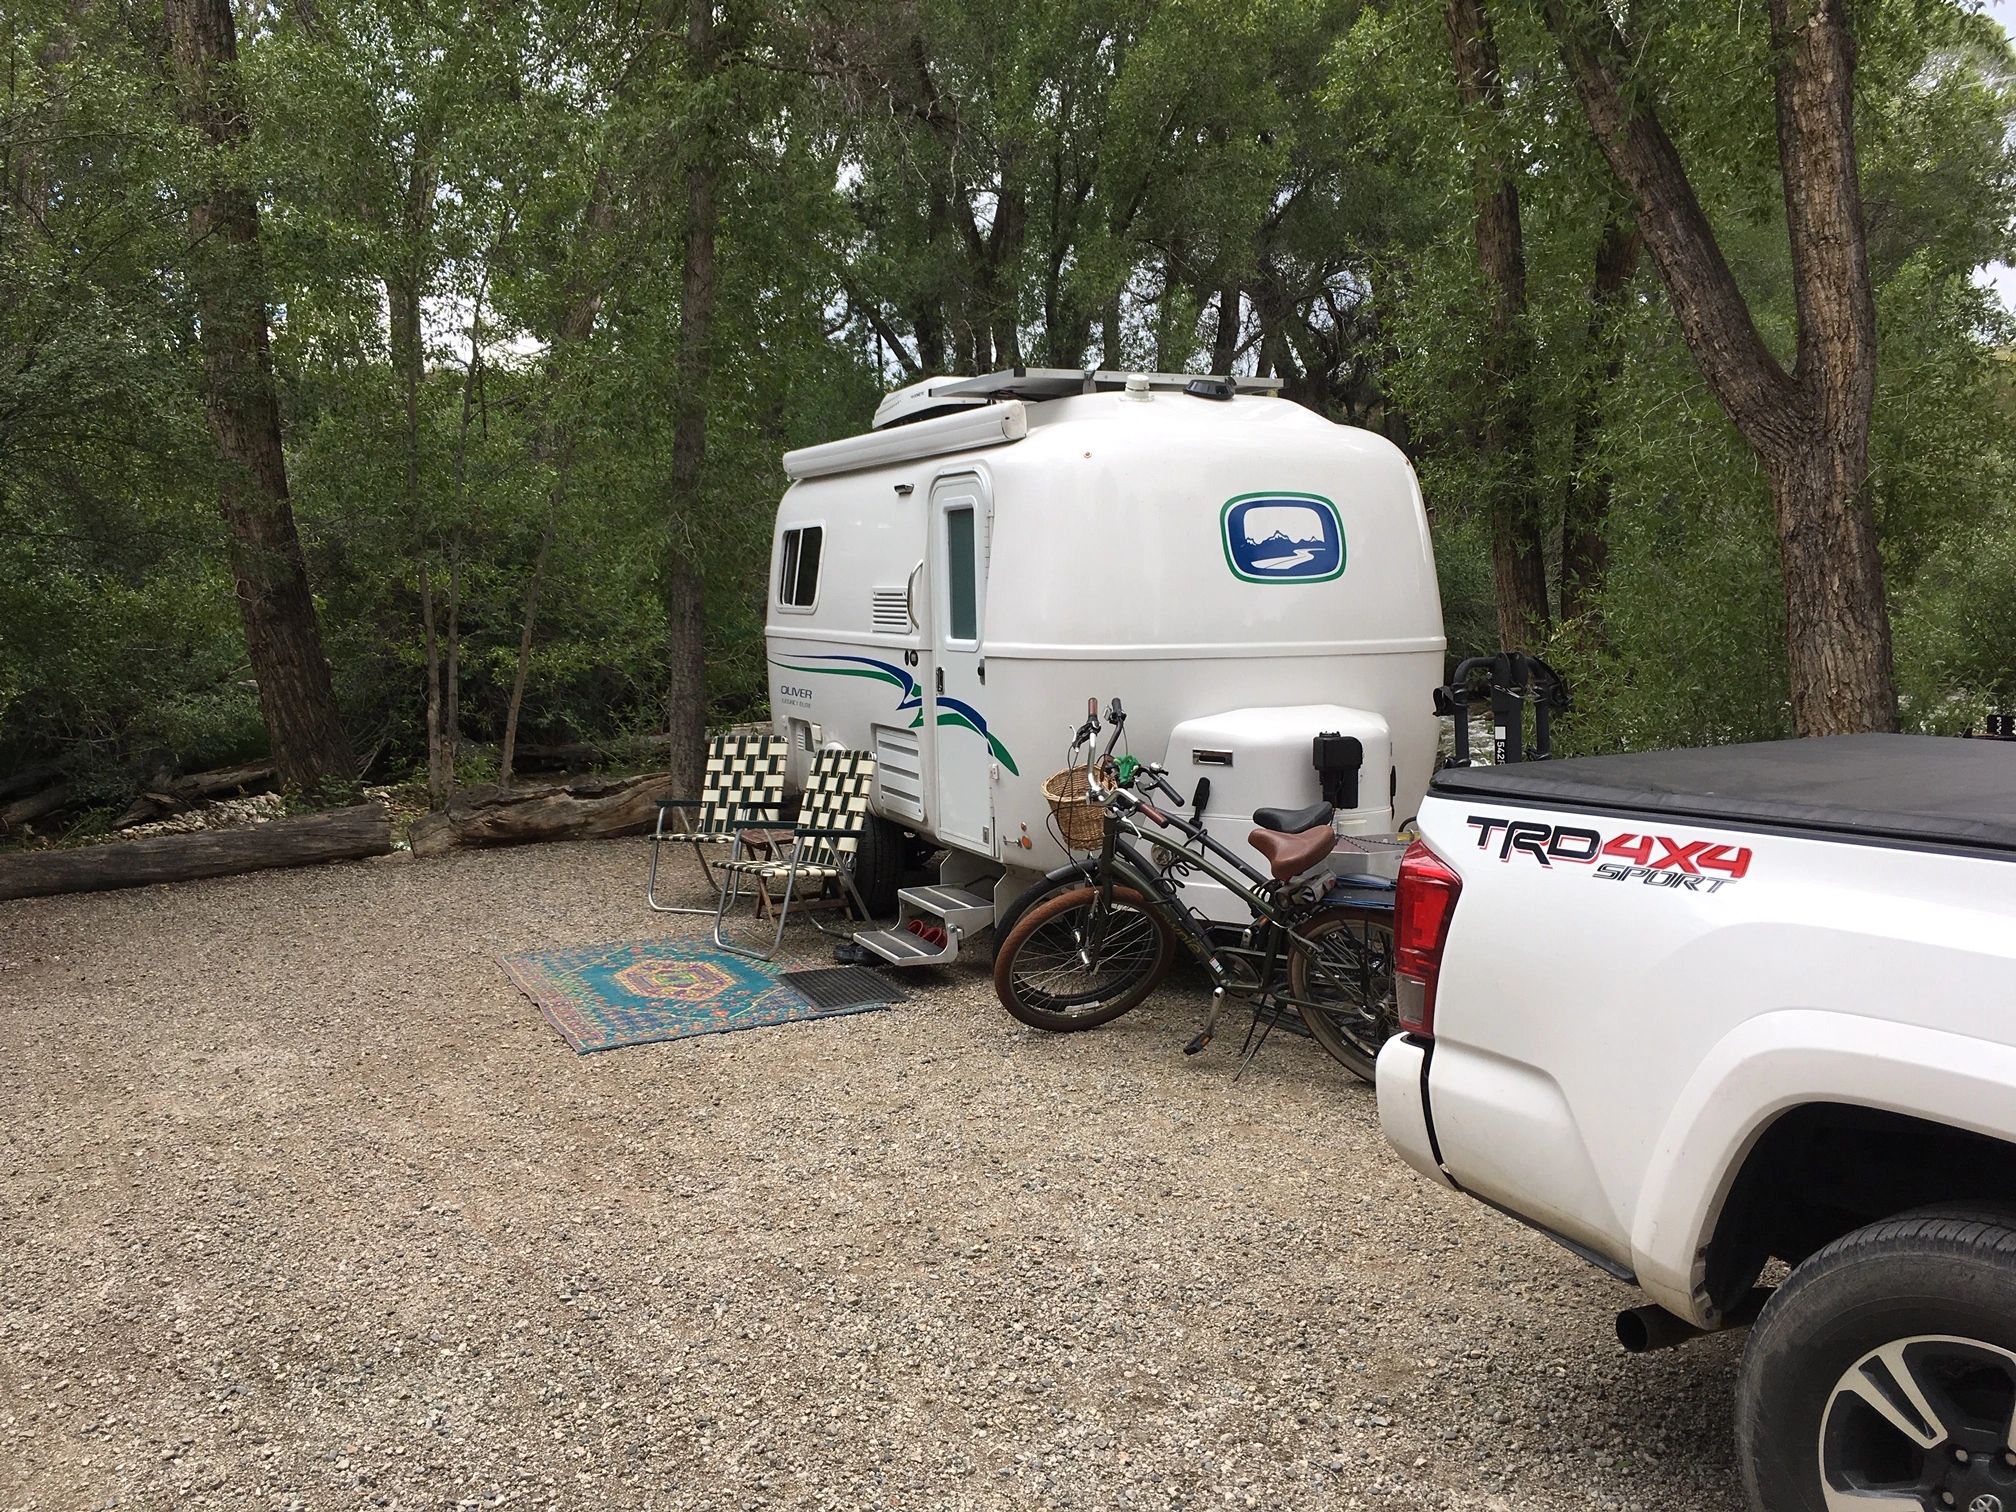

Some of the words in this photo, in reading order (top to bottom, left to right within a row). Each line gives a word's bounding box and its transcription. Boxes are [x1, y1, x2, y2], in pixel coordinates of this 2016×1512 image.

[780, 685, 812, 699] OLIVER
[1466, 815, 1603, 869] TRD
[1592, 863, 1738, 893] SPORT
